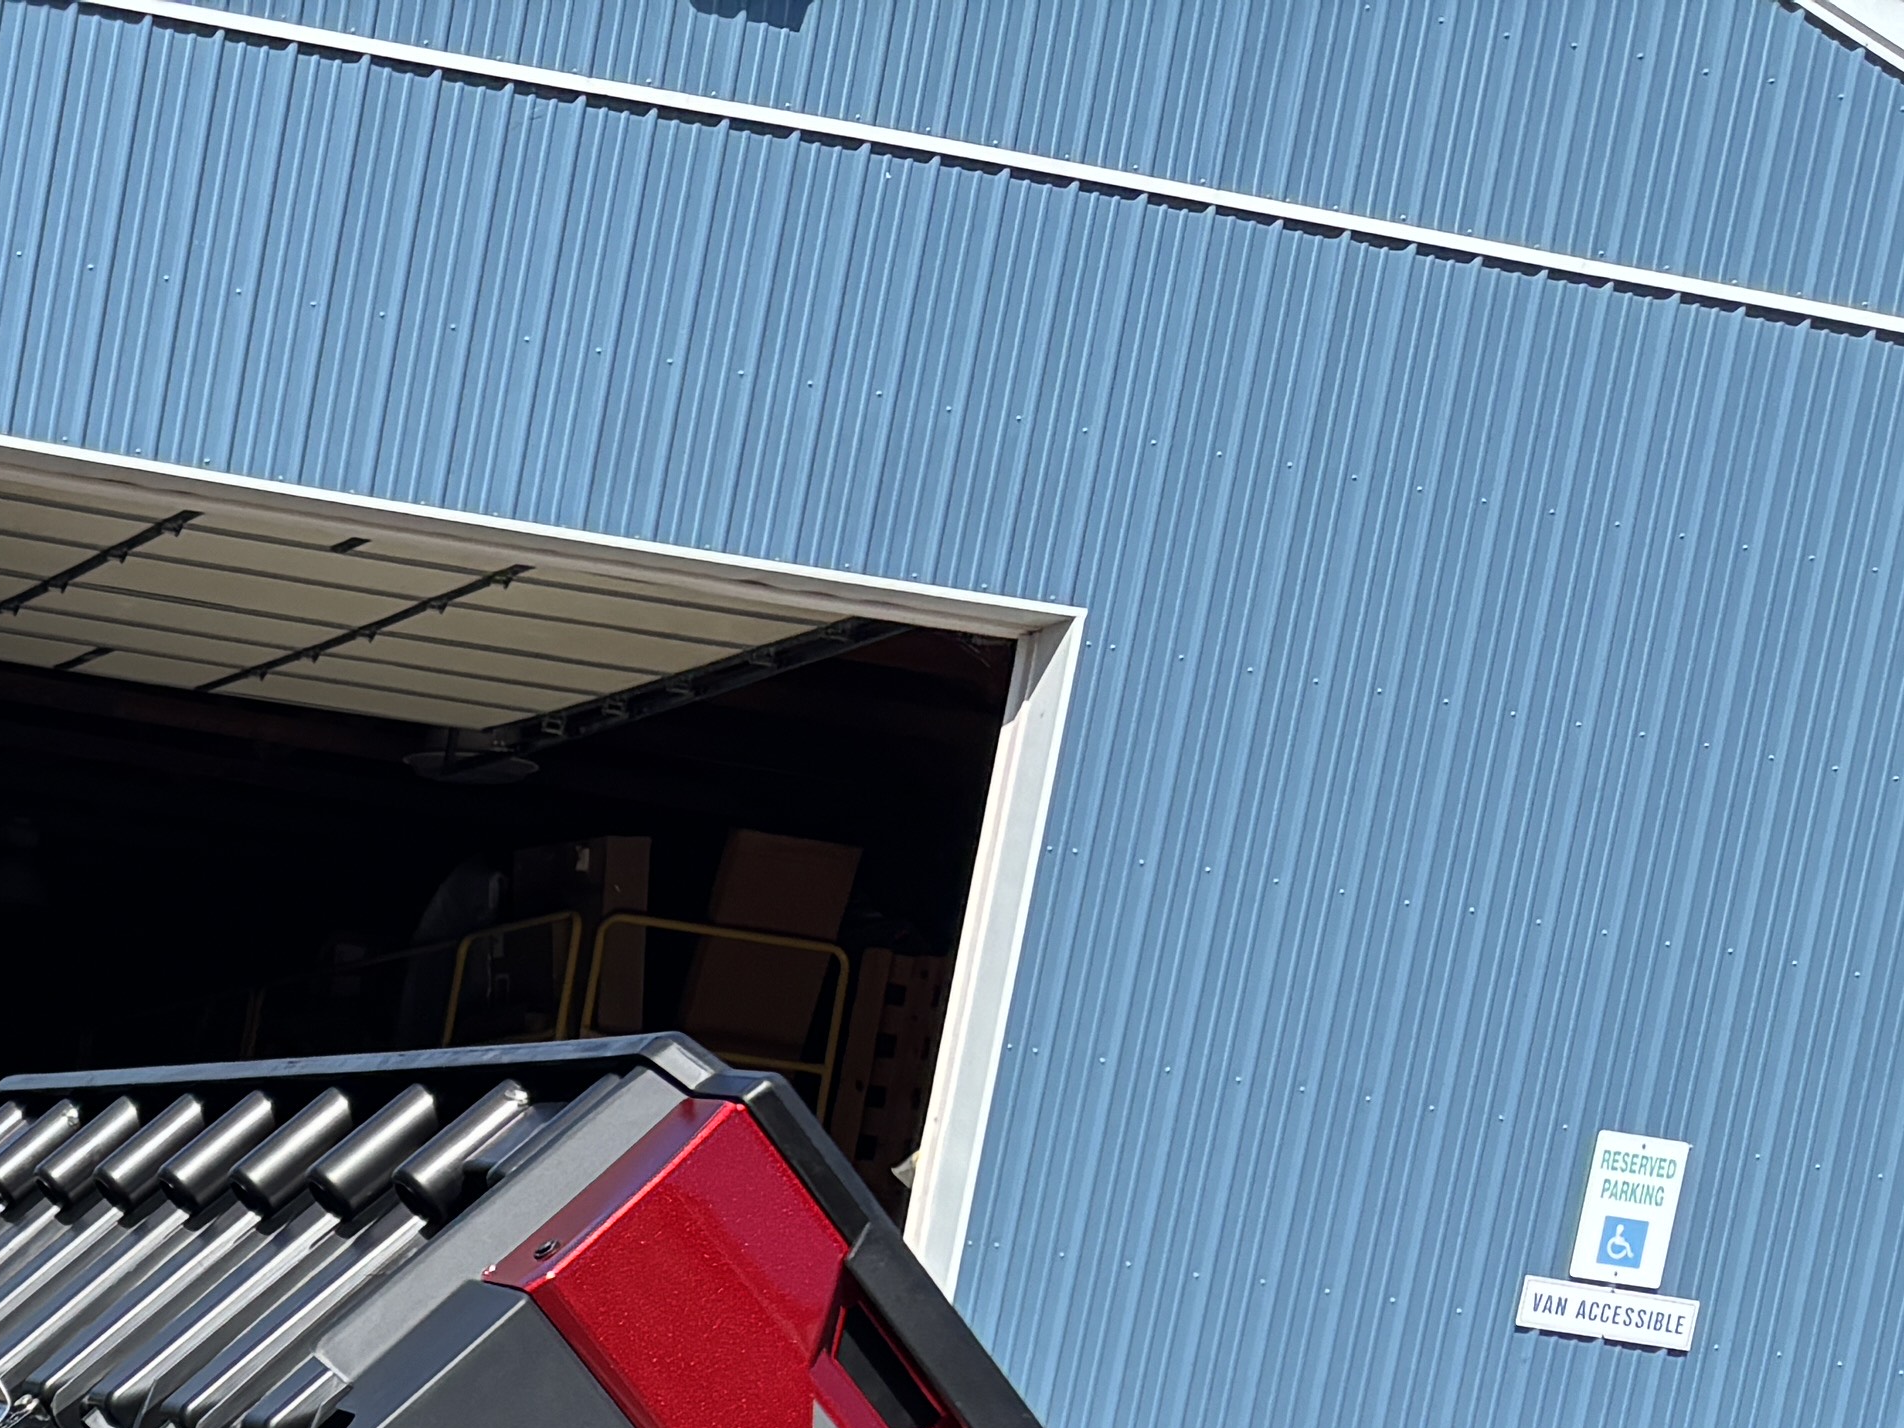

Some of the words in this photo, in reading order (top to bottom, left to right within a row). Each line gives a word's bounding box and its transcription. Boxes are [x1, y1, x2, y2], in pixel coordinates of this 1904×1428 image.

[1601, 1150, 1677, 1180] RESERVED
[1601, 1179, 1665, 1207] PARKING
[1533, 1292, 1568, 1315] VAN
[1576, 1301, 1686, 1334] ACCESSIBLE
